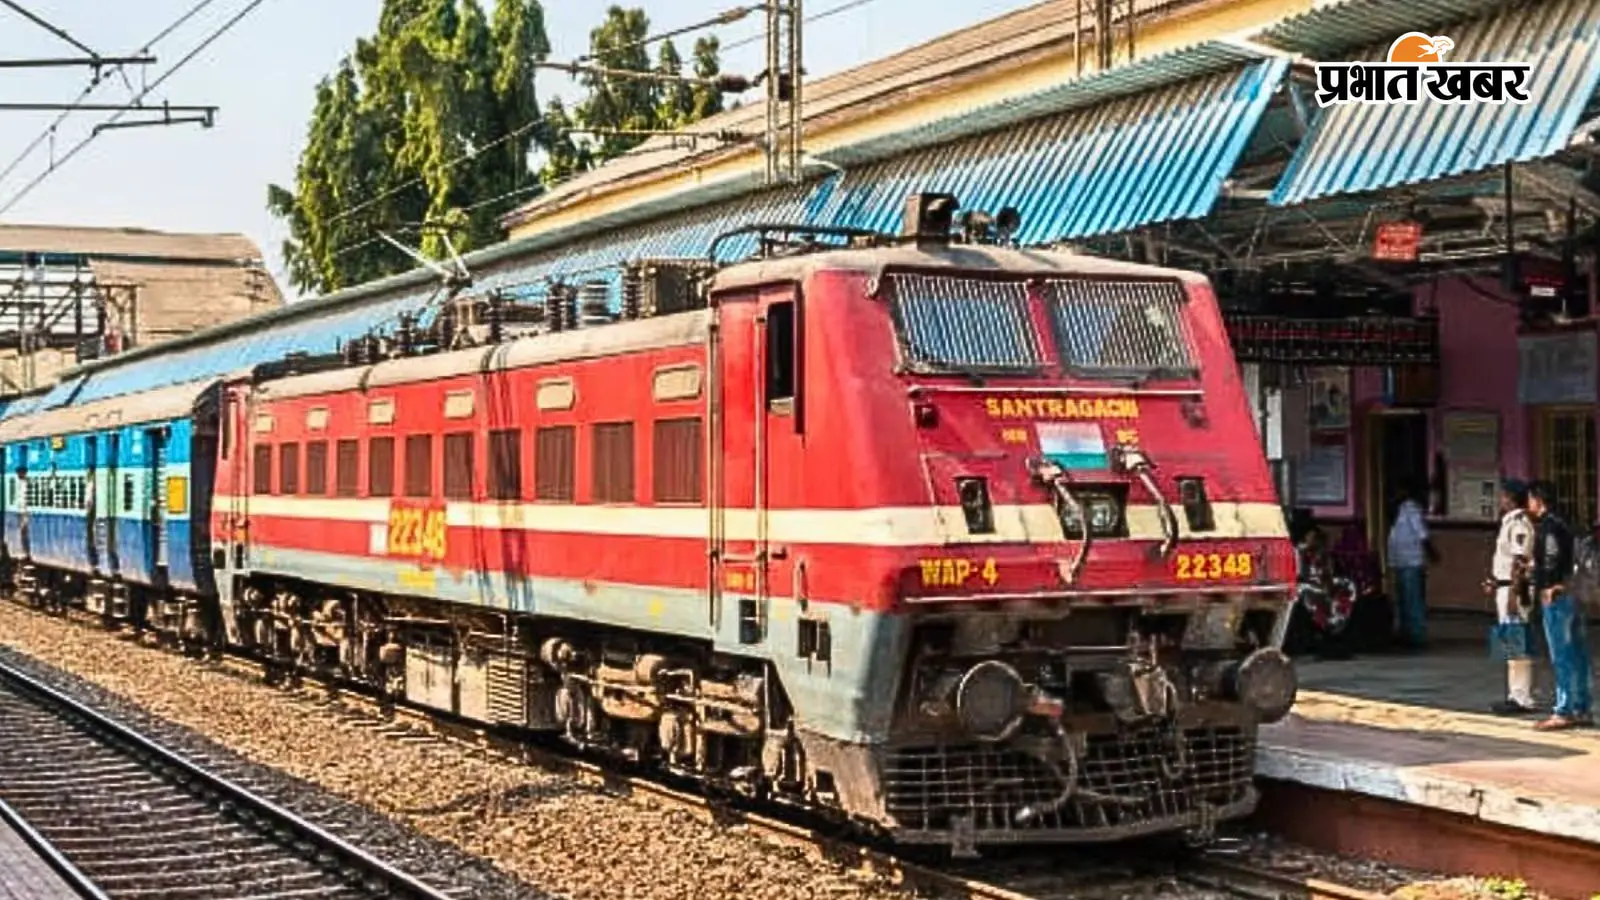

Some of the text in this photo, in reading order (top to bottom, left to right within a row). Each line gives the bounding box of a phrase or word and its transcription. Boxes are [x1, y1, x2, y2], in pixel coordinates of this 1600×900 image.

[389, 507, 446, 559] 22348
[920, 557, 999, 585] WAP-4
[1177, 553, 1252, 579] 22348
